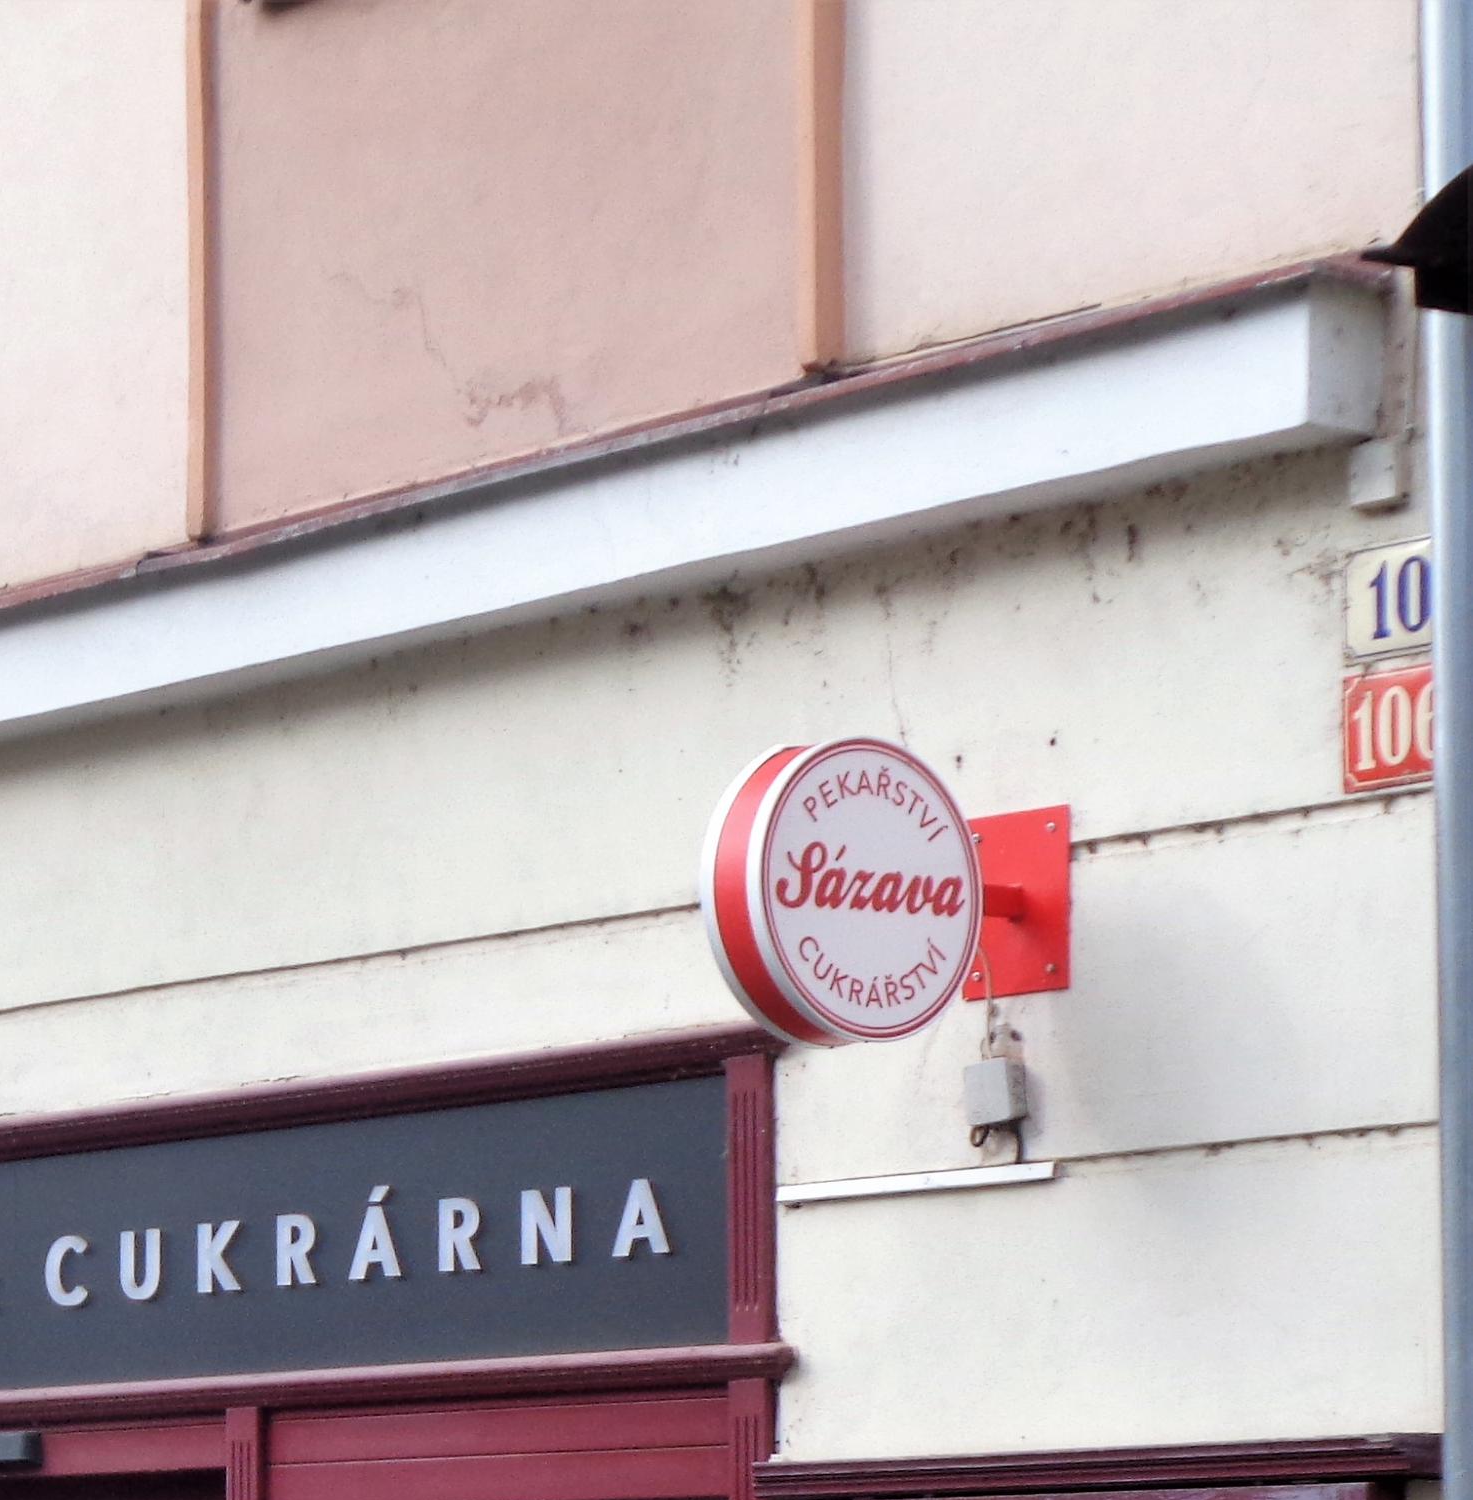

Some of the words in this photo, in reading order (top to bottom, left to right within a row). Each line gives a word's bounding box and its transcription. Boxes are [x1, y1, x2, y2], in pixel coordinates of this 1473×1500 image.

[803, 766, 949, 842] PEKAŘSTVÍ
[775, 841, 965, 917] Sázava
[799, 936, 947, 1009] CUKRÁŘSTVÍ
[44, 1178, 671, 1307] CUKRÁRNA
